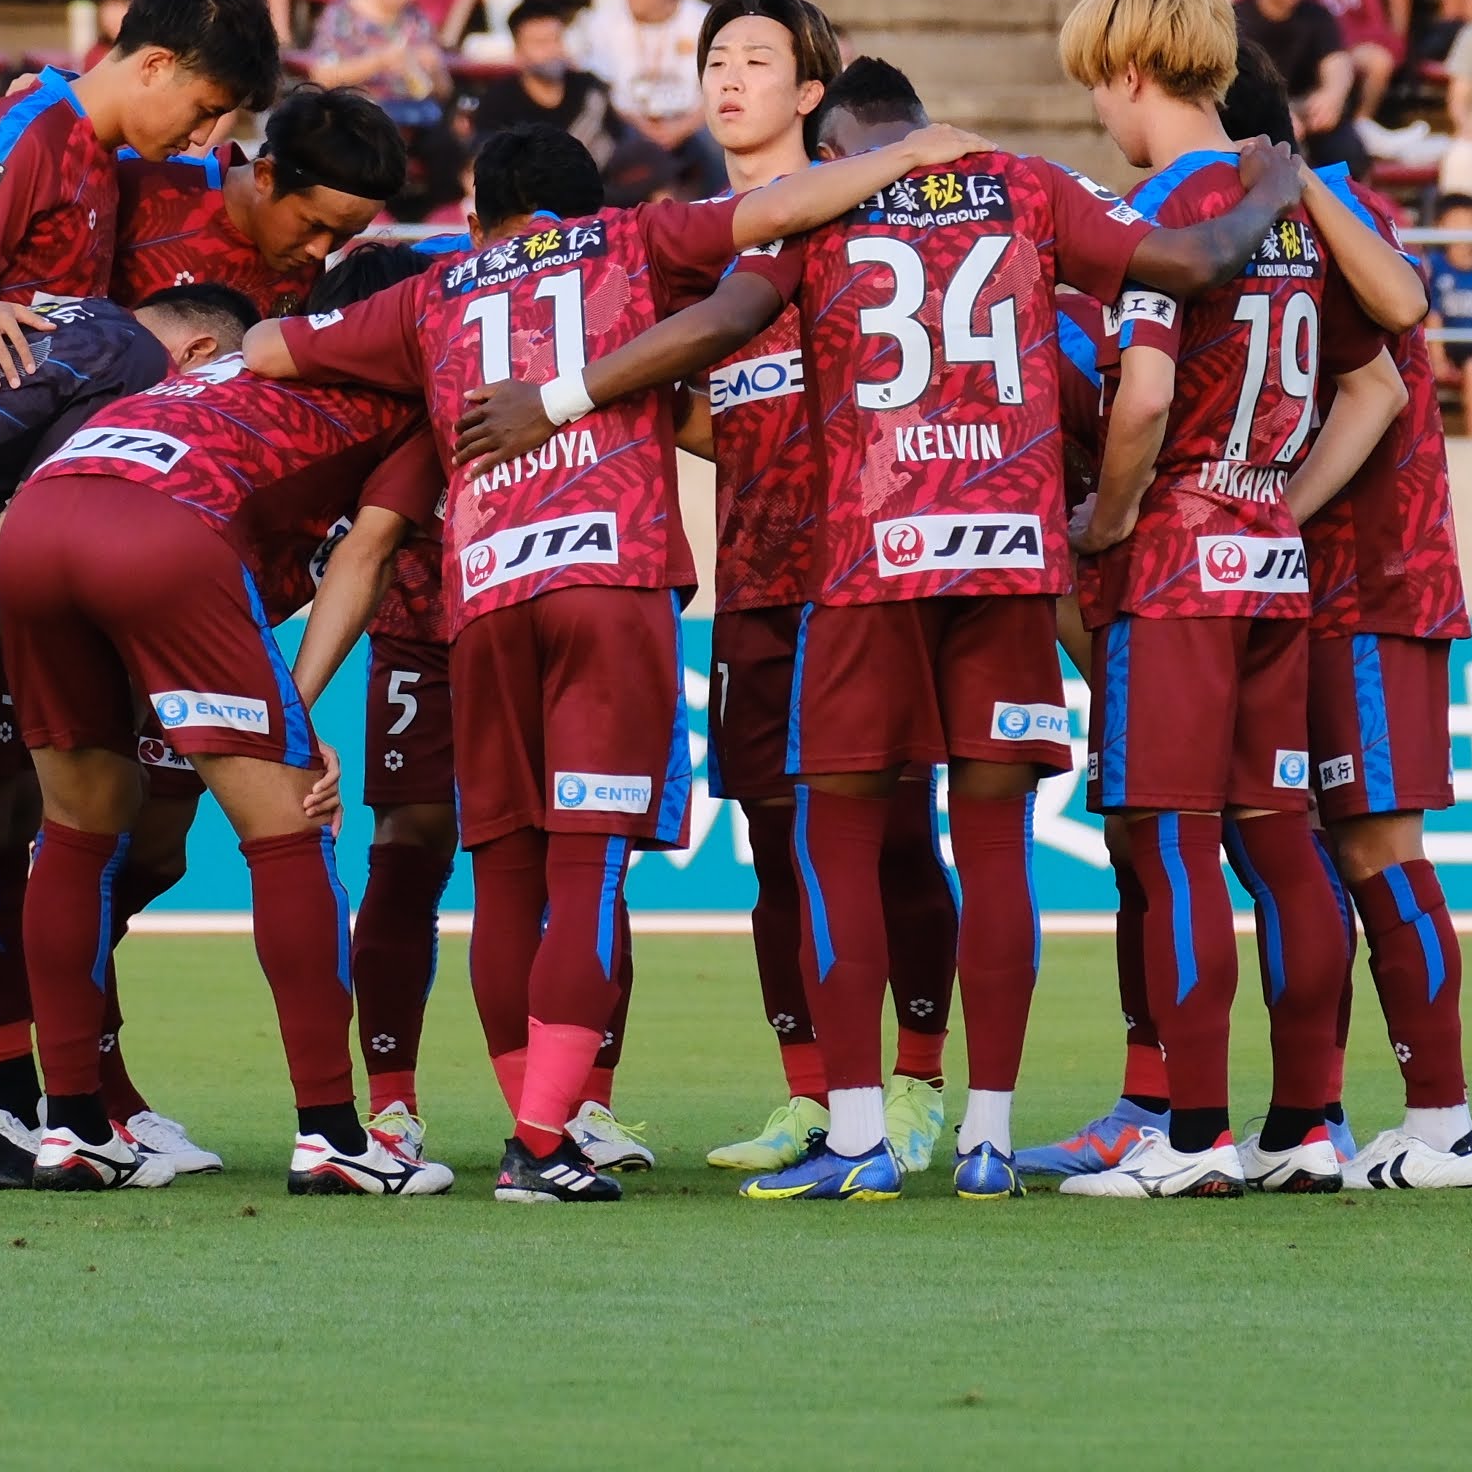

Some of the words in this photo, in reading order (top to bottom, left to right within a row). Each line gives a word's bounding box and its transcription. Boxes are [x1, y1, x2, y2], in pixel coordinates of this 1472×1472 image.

[887, 213, 935, 228] KOUWA
[936, 208, 991, 226] GROUP
[477, 266, 530, 288] KOUWA
[532, 250, 584, 272] GROUP
[462, 268, 588, 386] 11
[846, 234, 1025, 410] 34
[1223, 290, 1321, 464] 19
[71, 432, 179, 464] JTA
[895, 424, 1003, 462] KELVIN
[1197, 460, 1289, 505] TAKAYAS
[503, 522, 614, 570] JTA
[894, 553, 920, 563] JAL
[933, 524, 1040, 558] JTA
[471, 572, 491, 585] JAL
[1218, 571, 1242, 580] JAL
[195, 702, 265, 723] ENTRY
[386, 670, 422, 736] 5
[595, 786, 650, 802] ENTRY
